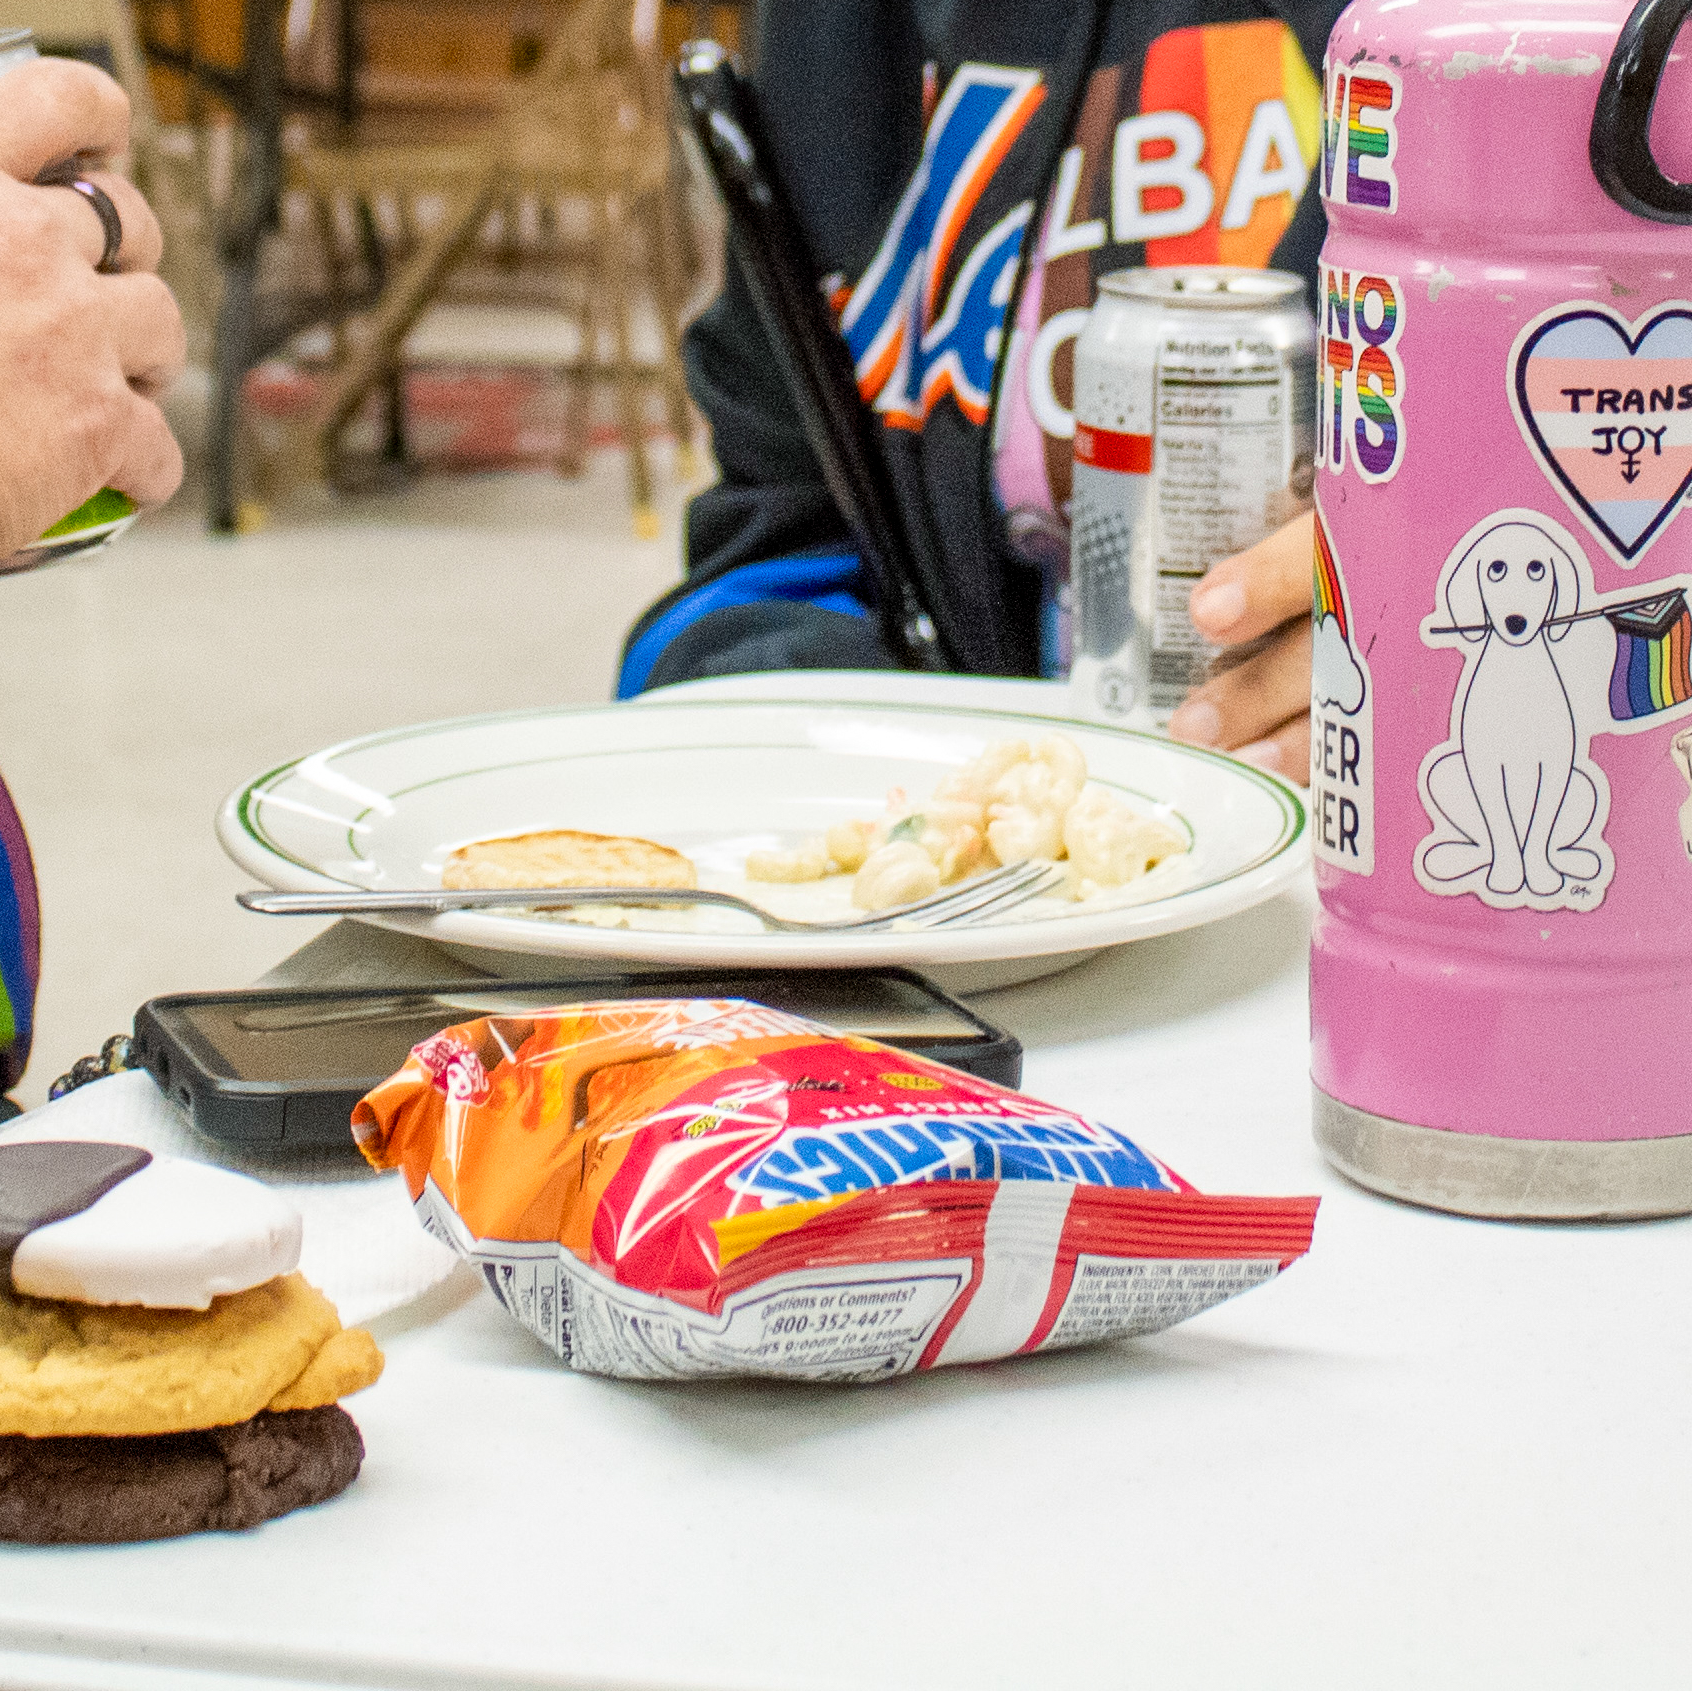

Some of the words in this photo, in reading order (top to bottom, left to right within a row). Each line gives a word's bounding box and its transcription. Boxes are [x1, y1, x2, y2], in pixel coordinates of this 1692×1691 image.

[1591, 425, 1668, 456] JOY
[820, 1295, 834, 1308] or
[839, 1286, 916, 1308] Comments?
[561, 1318, 574, 1361] Carb
[761, 1308, 903, 1342] 1-800-352-4477
